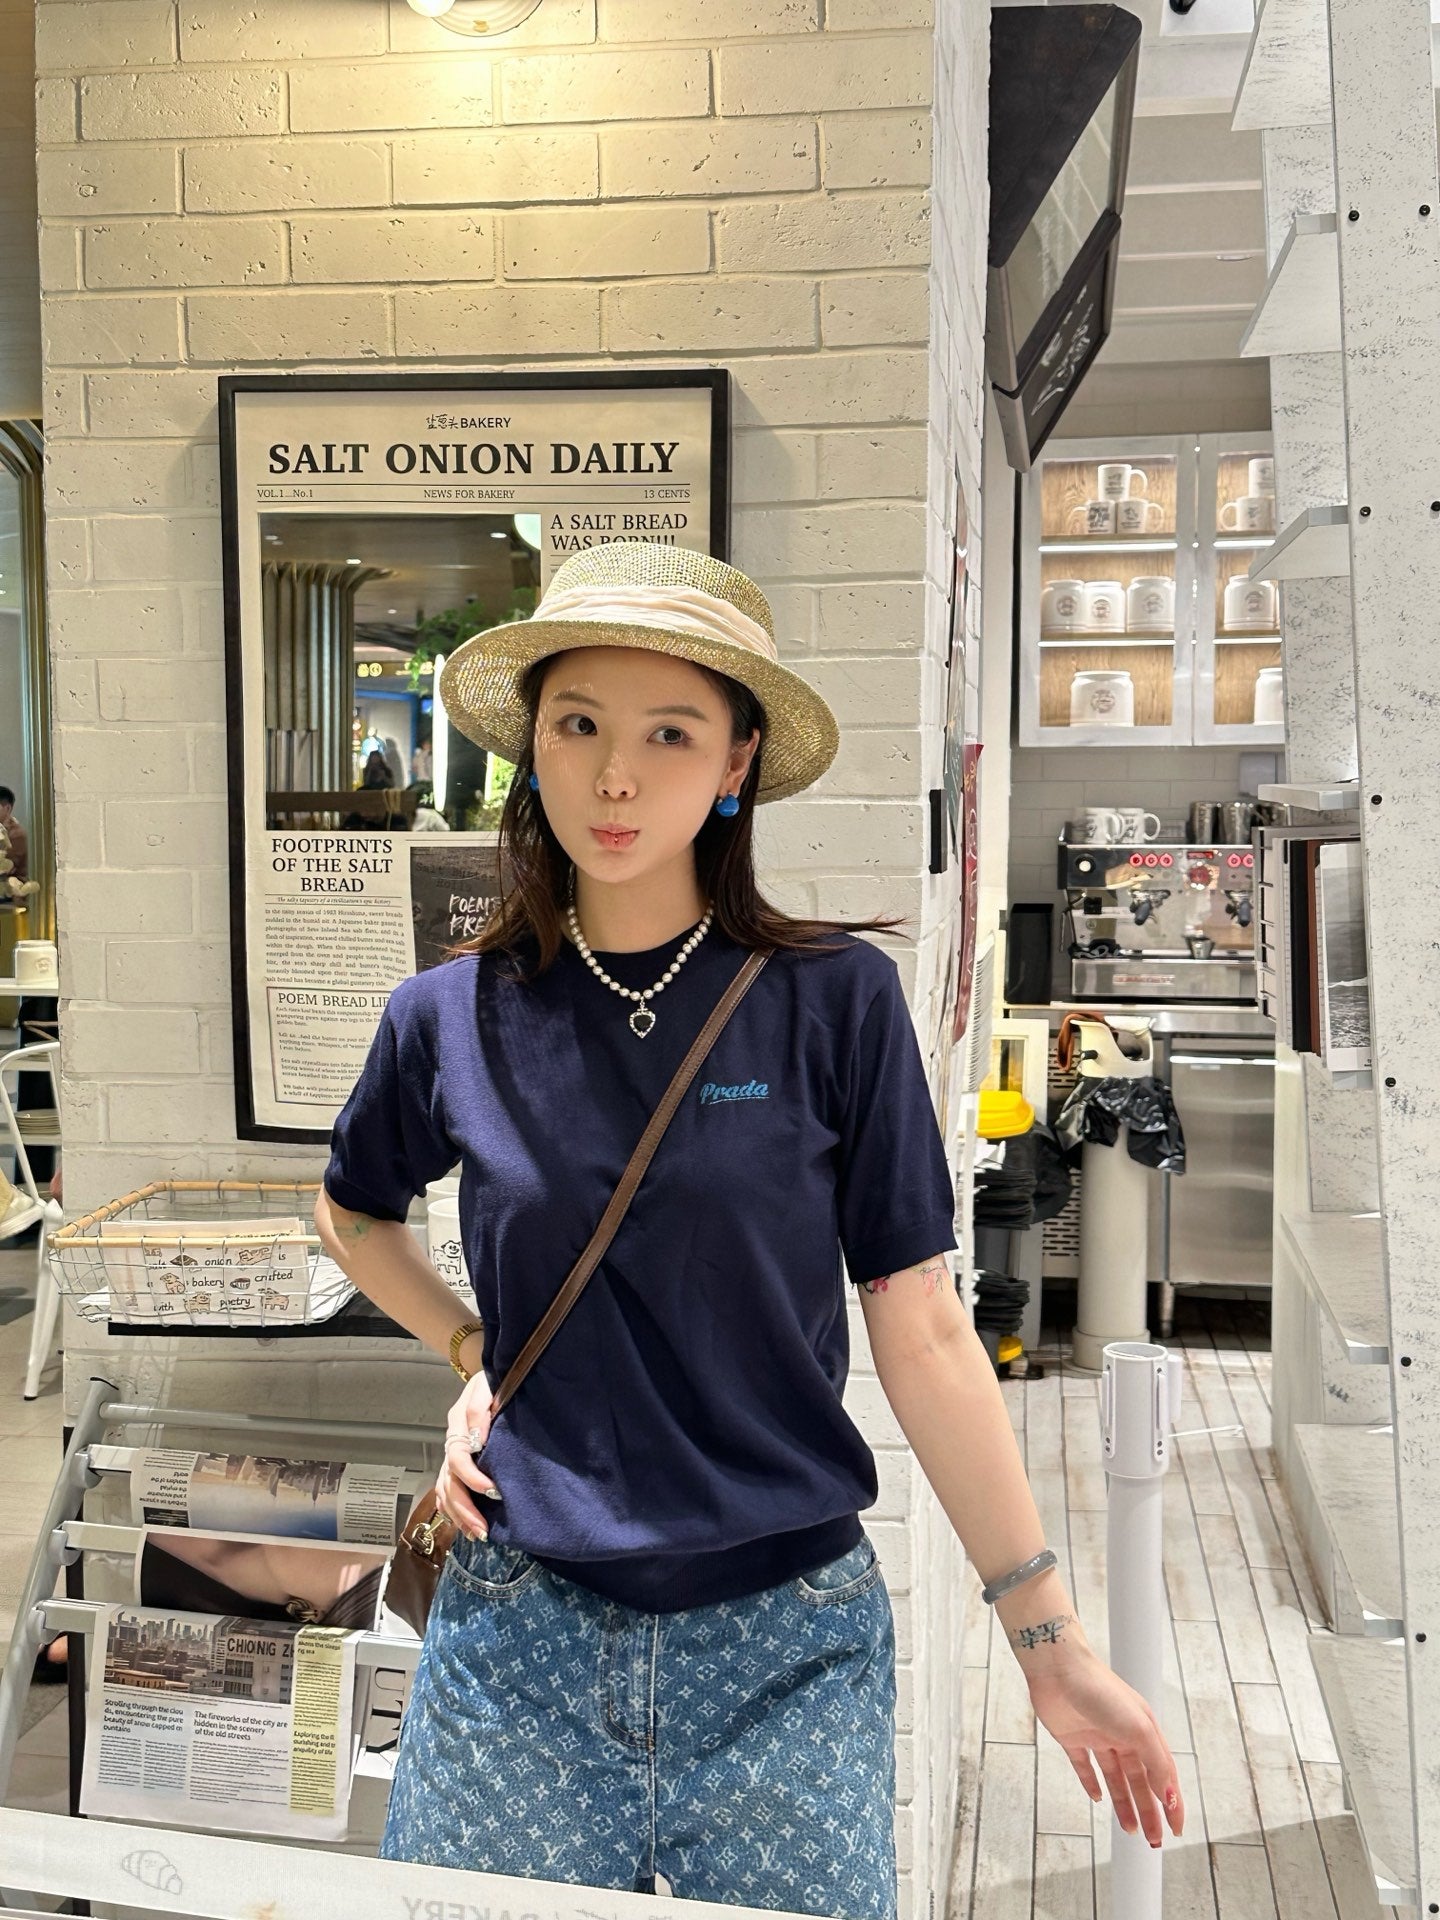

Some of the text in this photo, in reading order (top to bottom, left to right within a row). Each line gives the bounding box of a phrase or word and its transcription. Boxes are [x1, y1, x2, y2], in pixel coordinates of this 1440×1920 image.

[460, 417, 512, 429] BAKERY
[269, 442, 680, 474] SALT ONION DAILY
[424, 489, 515, 499] NEWS FOR BAKERY
[644, 489, 690, 499] 13 CENTS
[550, 513, 688, 530] A SALT BREAD
[551, 534, 592, 551] WAS
[272, 838, 393, 854] FOOTPRINTS
[272, 857, 393, 873] OF THE SALT
[300, 877, 364, 893] BREAD
[278, 992, 318, 1006] POEM
[322, 994, 368, 1008] BREAD
[700, 1080, 769, 1104] Prada
[192, 1277, 224, 1289] bakery
[104, 1698, 131, 1710] Scrolling
[132, 1703, 158, 1712] through
[114, 1709, 156, 1722] encountering
[194, 1710, 207, 1719] The
[208, 1713, 240, 1723] fireworks
[262, 1718, 275, 1728] city
[194, 1719, 218, 1728] hidden
[239, 1726, 266, 1736] scenery
[228, 1732, 251, 1740] streets
